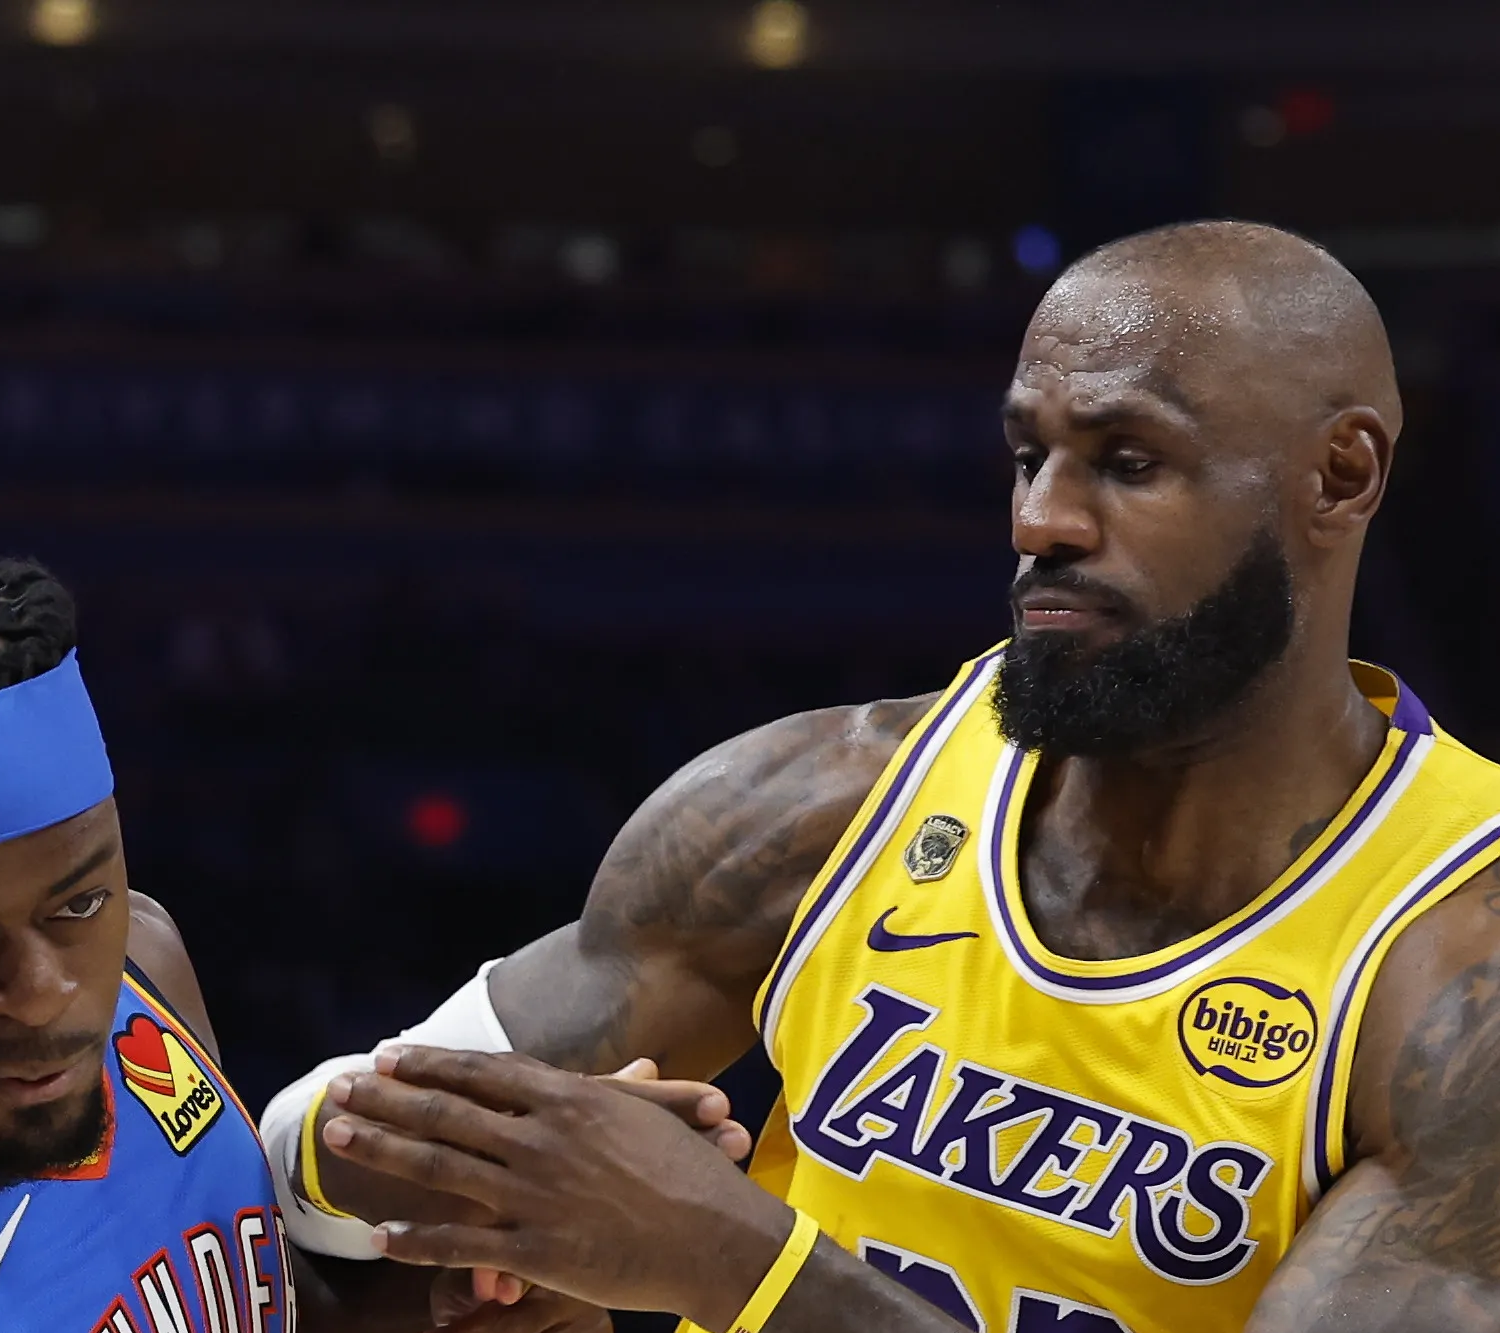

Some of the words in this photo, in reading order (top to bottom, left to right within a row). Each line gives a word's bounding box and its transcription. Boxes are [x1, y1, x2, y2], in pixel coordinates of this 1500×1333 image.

[926, 817, 964, 836] LEGACY
[1192, 997, 1310, 1061] bibigo
[1207, 1036, 1259, 1063] 비비고
[790, 983, 1274, 1288] LAKERS
